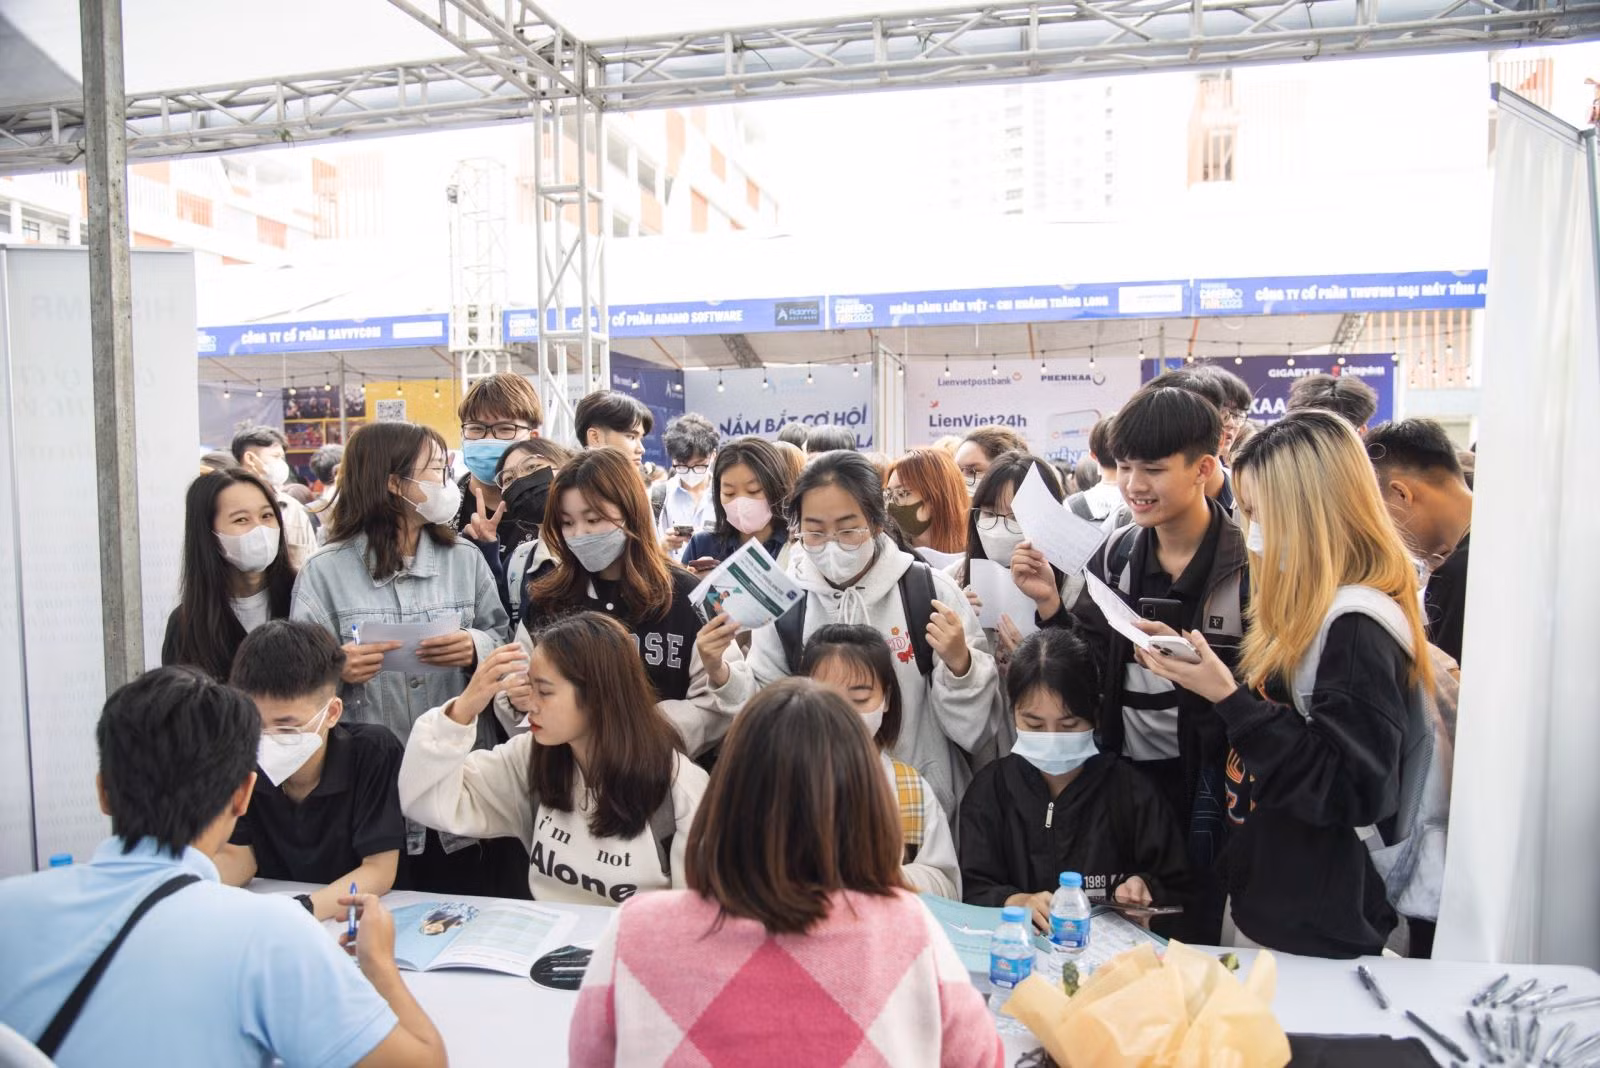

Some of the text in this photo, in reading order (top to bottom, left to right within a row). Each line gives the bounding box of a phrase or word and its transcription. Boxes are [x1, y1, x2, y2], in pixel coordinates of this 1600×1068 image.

[691, 310, 743, 324] SOFTWARE
[1041, 374, 1092, 382] PHENIKAA
[1268, 368, 1321, 378] GIGABYTE
[937, 376, 1012, 388] Lienvietpostbank
[928, 413, 1027, 428] LienViet24h
[597, 849, 632, 867] not
[530, 841, 637, 903] Alone
[1084, 875, 1106, 889] 1989
